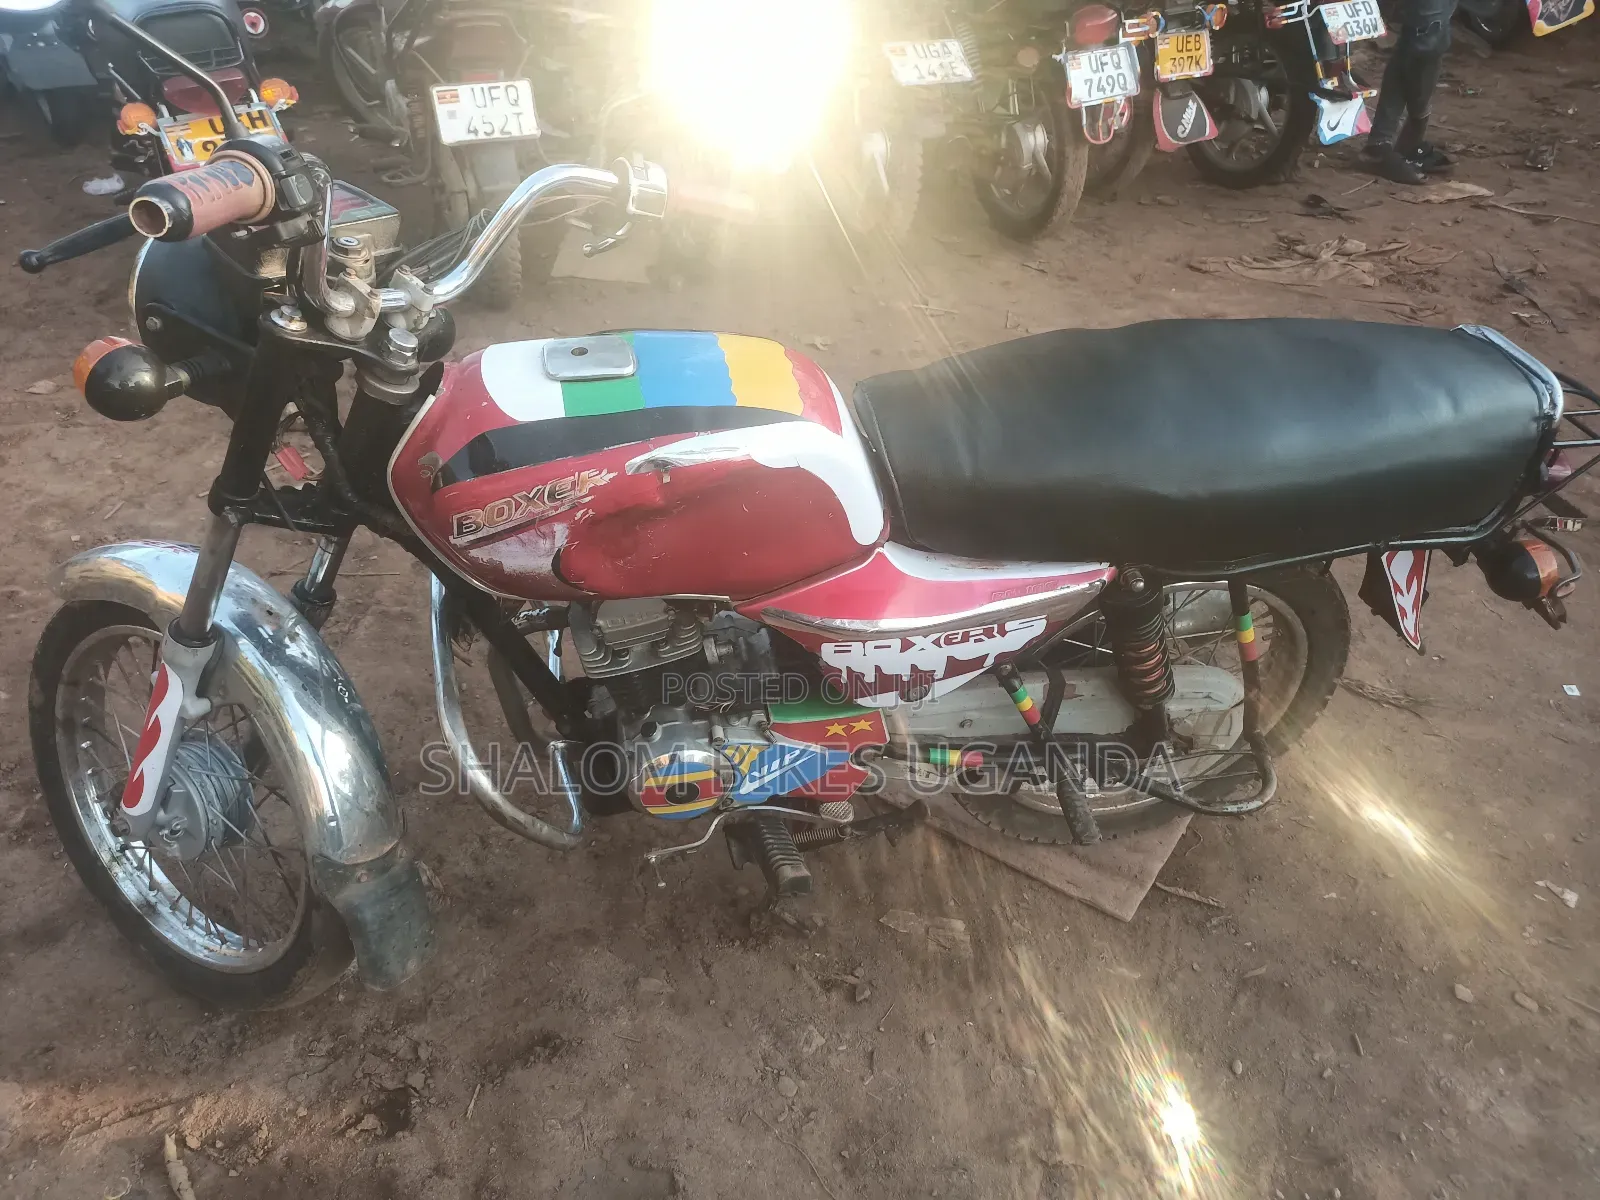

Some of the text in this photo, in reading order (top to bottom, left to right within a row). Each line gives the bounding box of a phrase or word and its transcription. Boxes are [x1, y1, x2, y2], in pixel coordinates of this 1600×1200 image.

[1343, 1, 1373, 18] UFD
[913, 42, 952, 59] UGA
[1176, 34, 1202, 53] UEB
[1088, 50, 1122, 74] UFQ
[1169, 54, 1203, 75] 397K
[471, 84, 520, 109] UFQ
[1084, 73, 1128, 98] 749Q
[208, 109, 269, 136] UH
[467, 112, 524, 137] 452T
